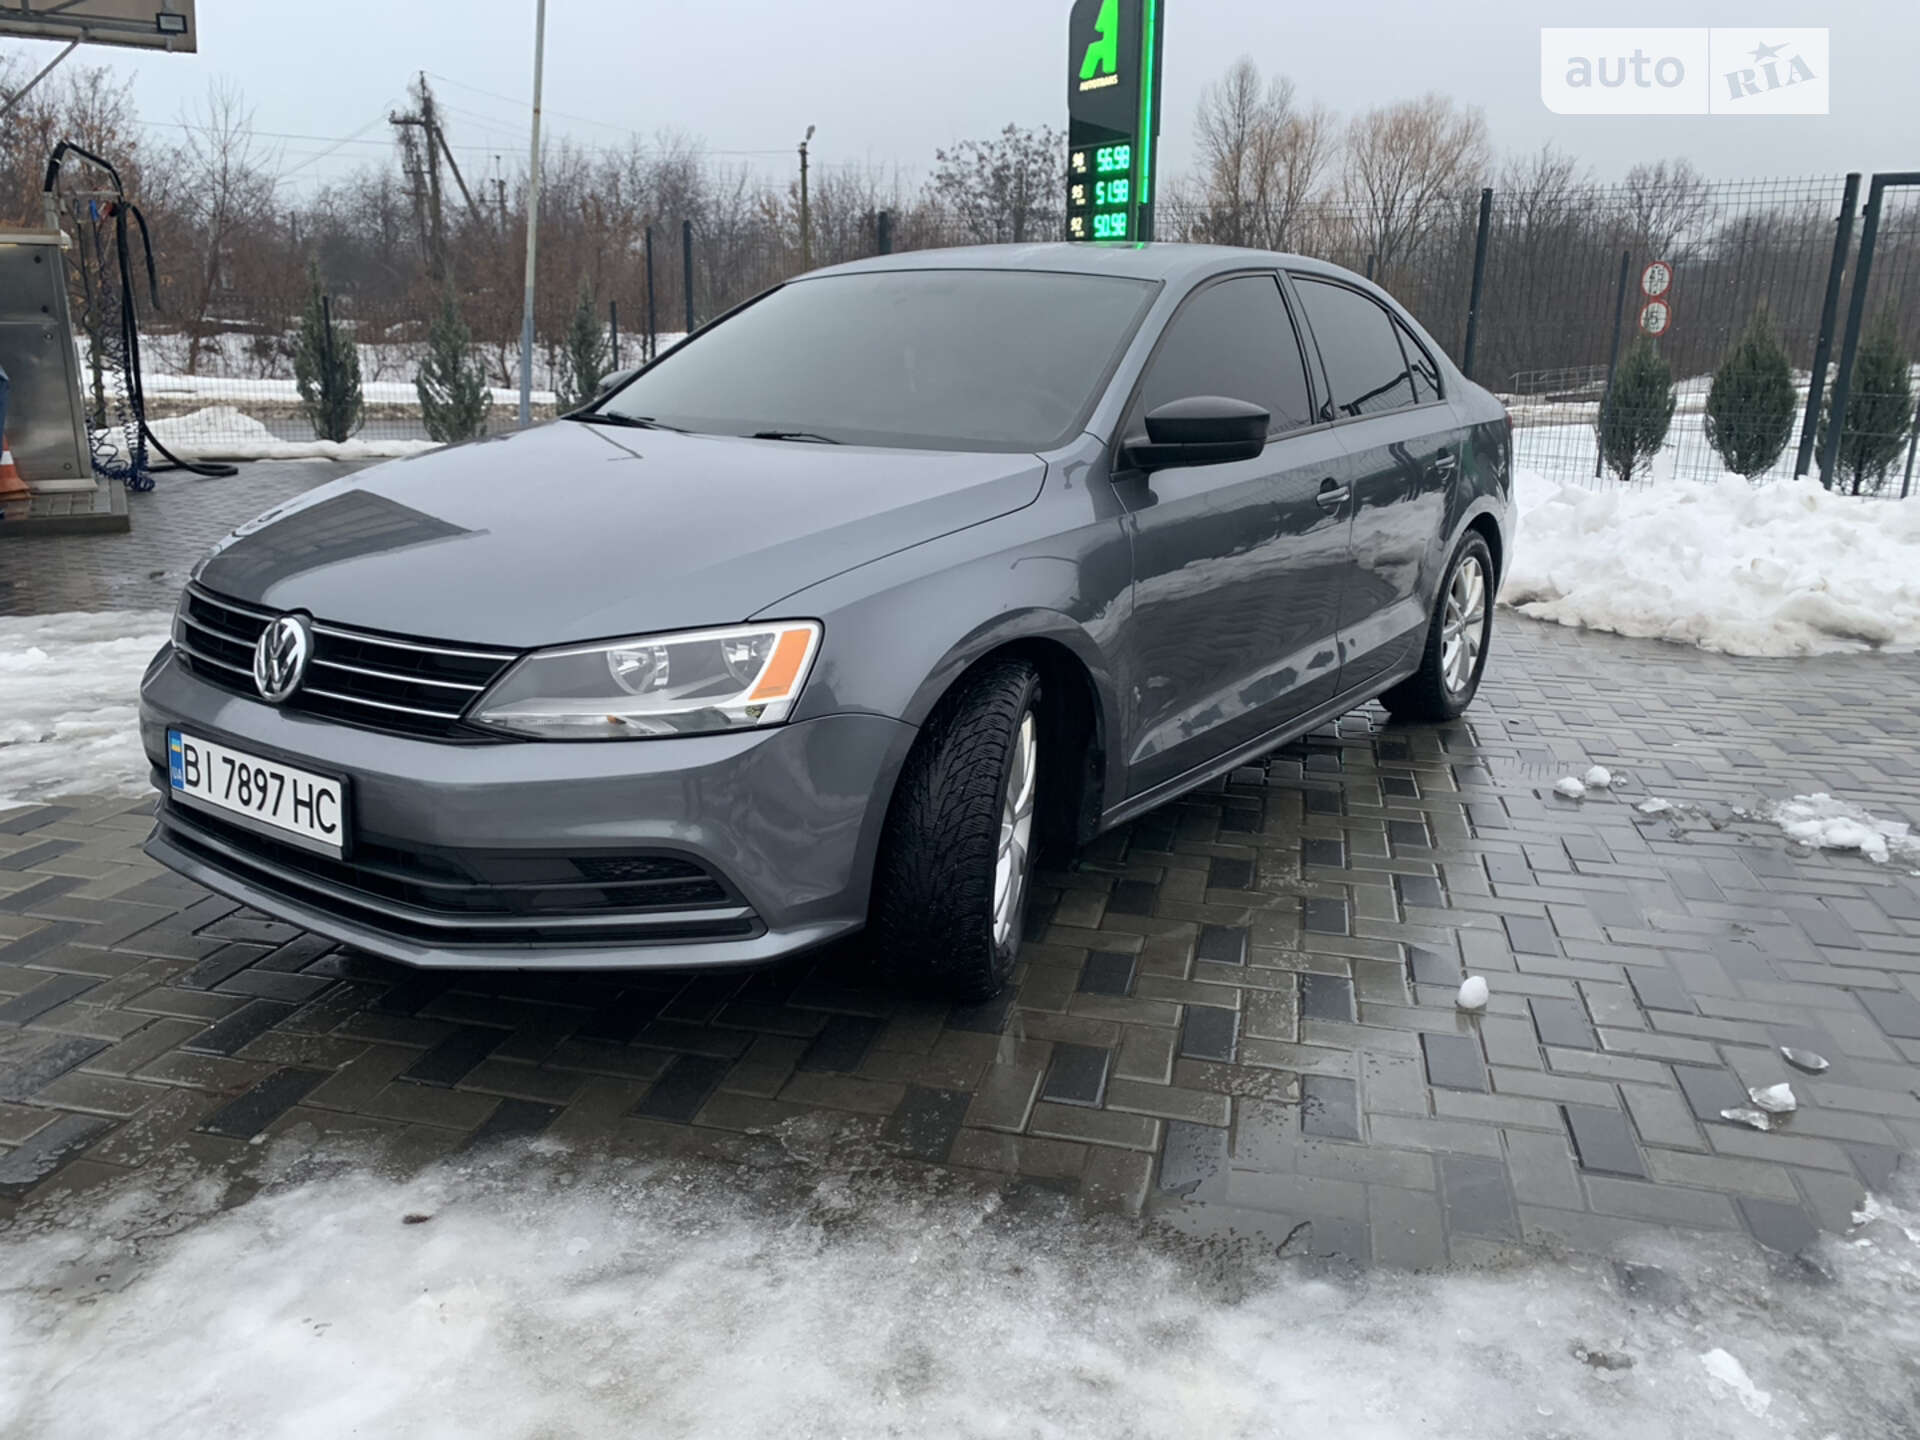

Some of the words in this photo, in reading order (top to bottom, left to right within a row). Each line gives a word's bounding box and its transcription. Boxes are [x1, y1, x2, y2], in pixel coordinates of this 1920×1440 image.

[184, 743, 212, 794] BI
[222, 756, 284, 816] 7897
[293, 778, 337, 834] HC
